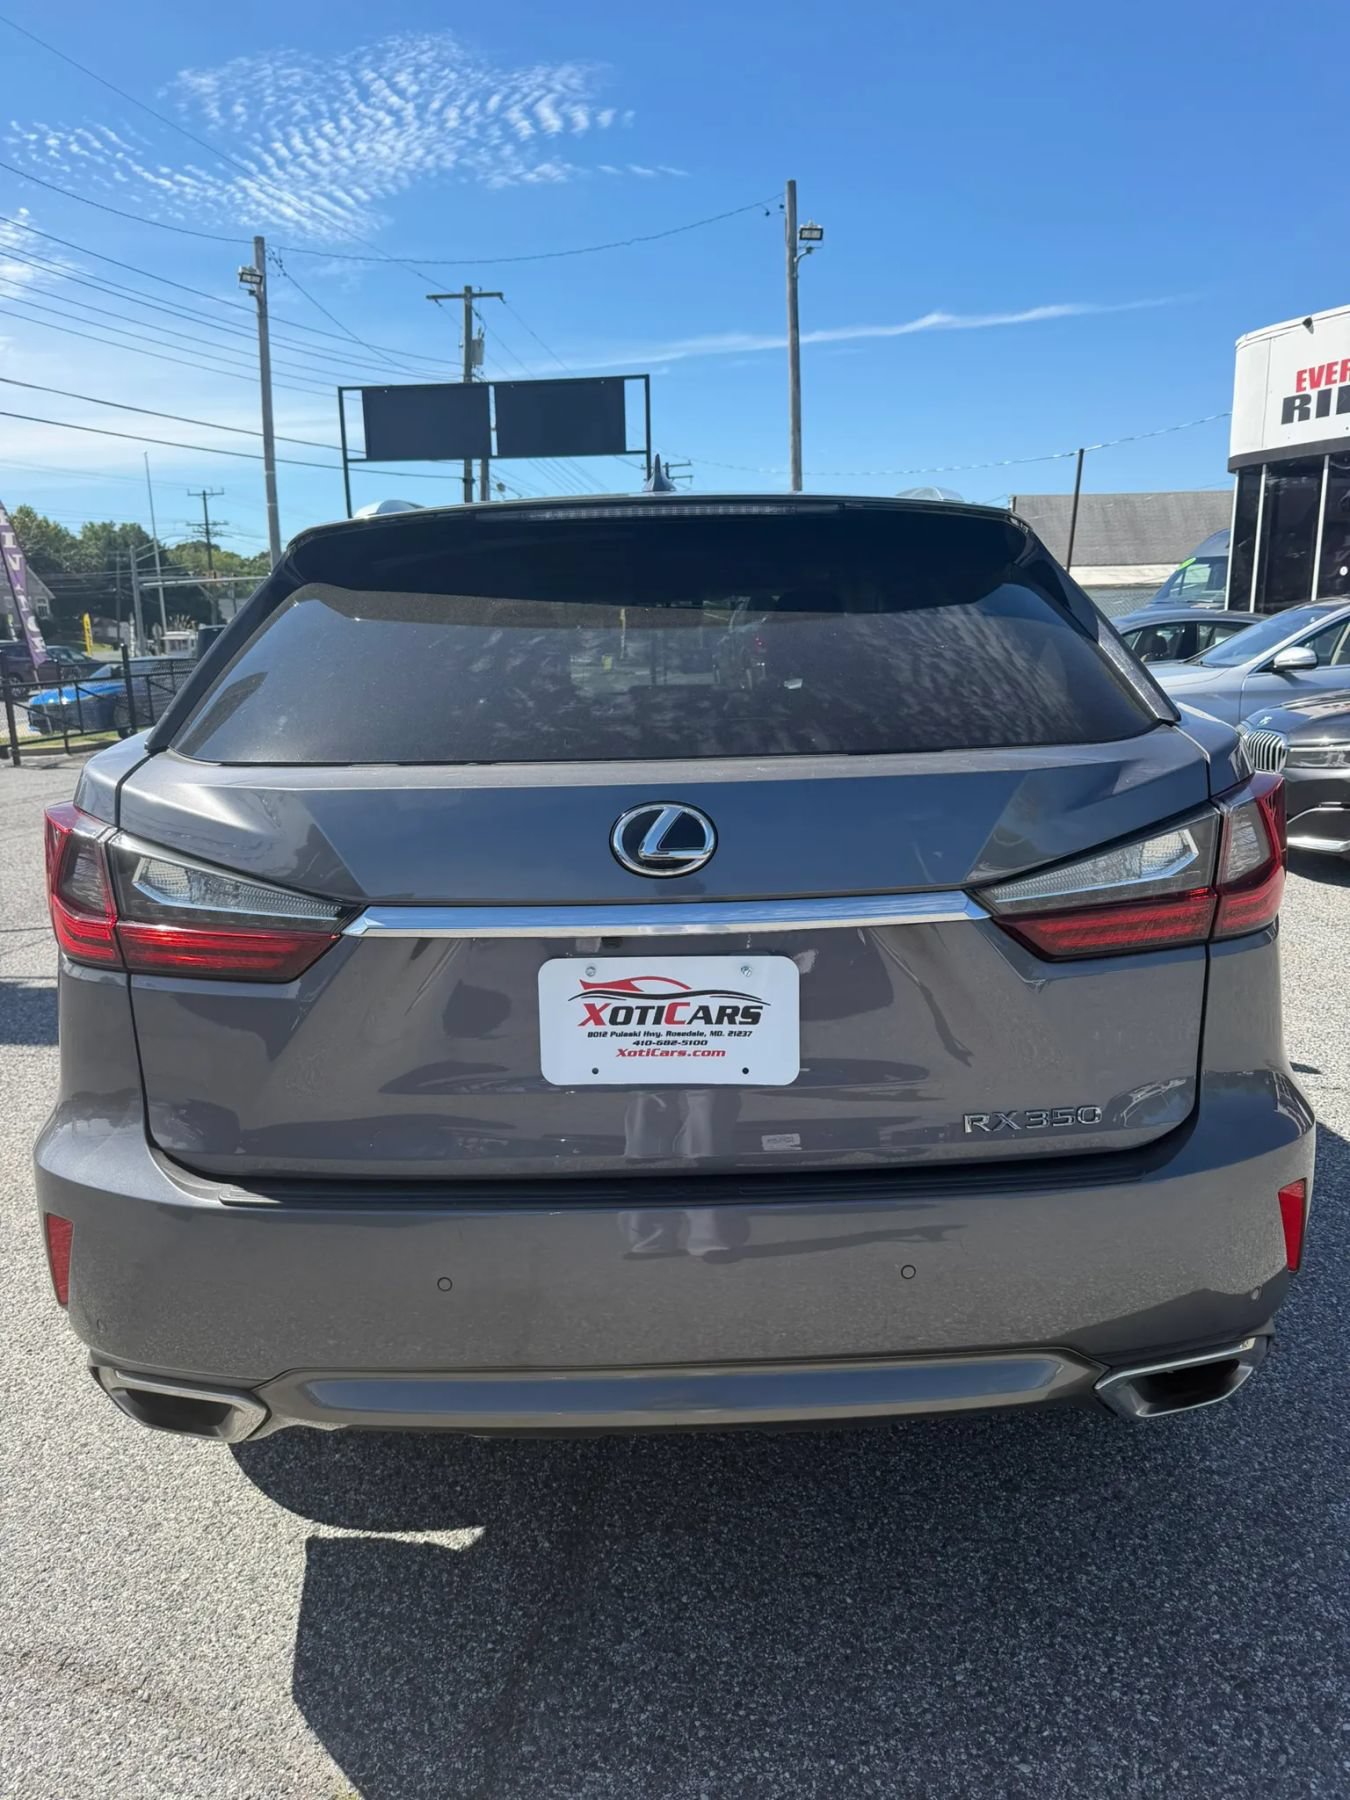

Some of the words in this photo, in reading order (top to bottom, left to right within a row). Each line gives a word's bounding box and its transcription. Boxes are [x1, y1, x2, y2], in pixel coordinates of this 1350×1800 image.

[609, 1030, 641, 1038] Pulaski
[643, 1030, 663, 1039] Hwy.
[666, 1030, 707, 1038] Rosedale,
[727, 1030, 753, 1038] 21237
[616, 1048, 726, 1058] XotiCars.com
